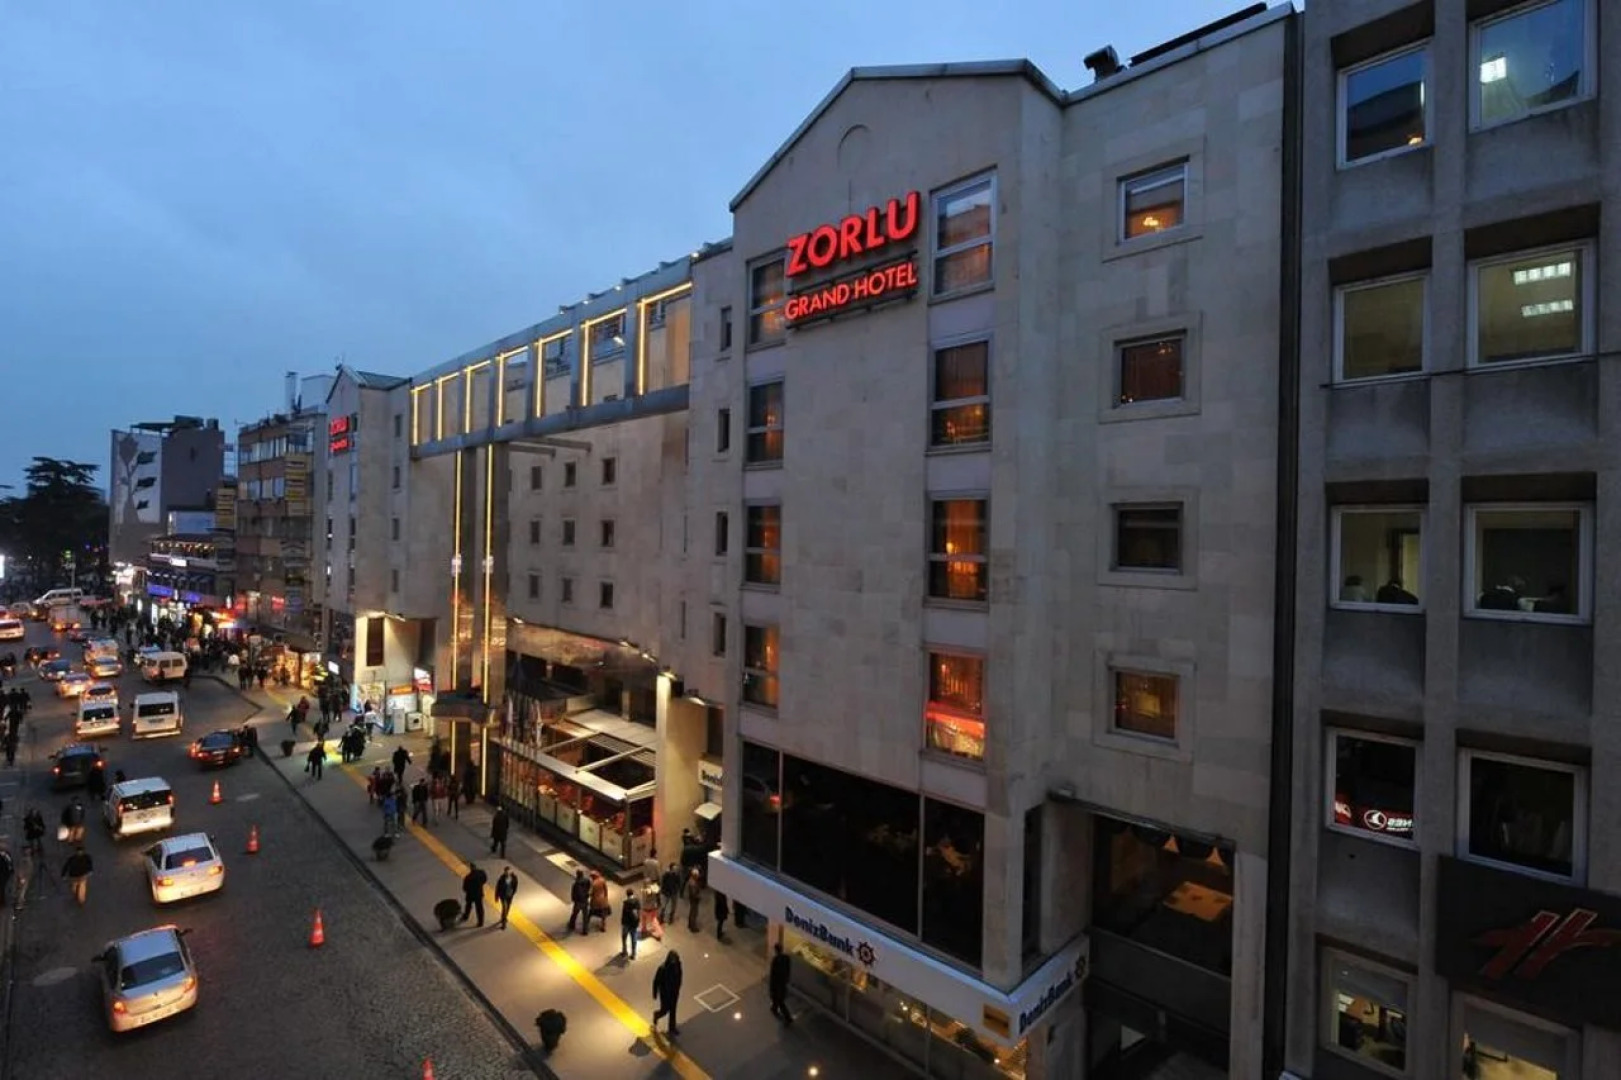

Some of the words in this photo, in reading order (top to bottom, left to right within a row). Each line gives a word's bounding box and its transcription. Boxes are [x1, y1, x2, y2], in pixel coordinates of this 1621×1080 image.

[786, 191, 920, 277] ZORLU
[785, 283, 850, 320] GRAND
[854, 262, 918, 300] HOTEL
[785, 906, 854, 956] DenizBank
